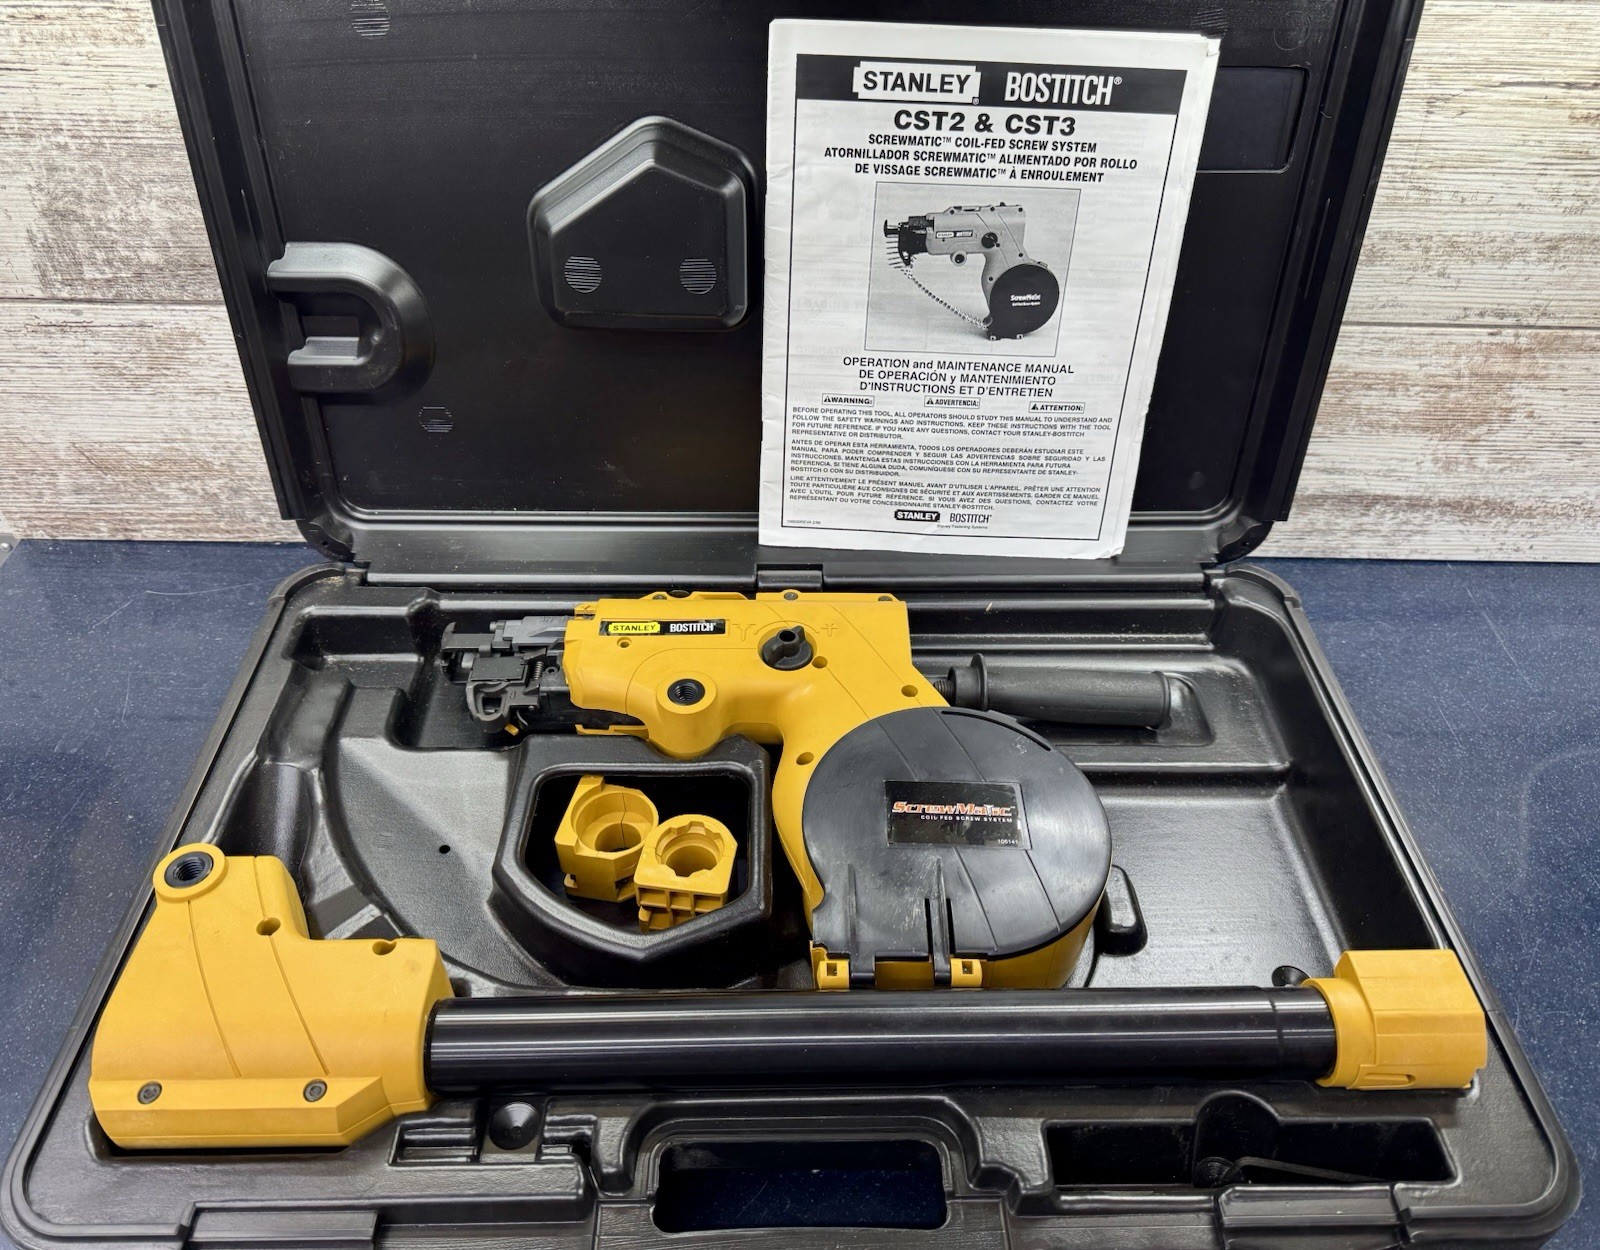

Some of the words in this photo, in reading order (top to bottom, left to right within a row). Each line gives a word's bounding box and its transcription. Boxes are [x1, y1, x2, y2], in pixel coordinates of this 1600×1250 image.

[863, 70, 971, 94] STANLEY
[894, 109, 965, 132] CST2
[974, 113, 994, 133] &
[1005, 113, 1076, 136] CST3
[954, 137, 1006, 148] COIL-FED
[1008, 139, 1048, 150] SCREW
[1051, 140, 1097, 152] SYSTEM
[824, 147, 910, 159] ATORNILLADOR
[998, 153, 1071, 166] ALIMENTADO
[1073, 156, 1097, 167] POR
[1099, 157, 1138, 168] ROLLO
[854, 163, 869, 173] DE
[873, 163, 920, 175] VISSAGE
[1009, 167, 1017, 178] À
[1020, 169, 1104, 181] ENROULEMENT
[843, 356, 910, 368] OPERATION
[912, 359, 933, 369] and
[936, 360, 1022, 372] MAINTENANCE
[1024, 363, 1075, 373] MANUAL
[859, 369, 874, 378] DE
[877, 368, 947, 381] OPERACIÓN
[950, 375, 956, 383] y
[959, 373, 1056, 385] MANTENIMIENTO
[859, 381, 955, 393] D'INSTRUCTIONS
[959, 385, 974, 394] ET
[976, 386, 1053, 396] D'ENTRETIEN
[830, 396, 873, 405] WARNING:
[935, 398, 979, 407] ADVERTENCIA:
[1040, 404, 1084, 412] ATTENTION:
[791, 428, 846, 436] REPRESENTATIVE
[806, 475, 855, 483] ATTENTIVEMENT
[872, 499, 931, 507] CONCESSIONNAIRE
[896, 511, 938, 520] STANLEY
